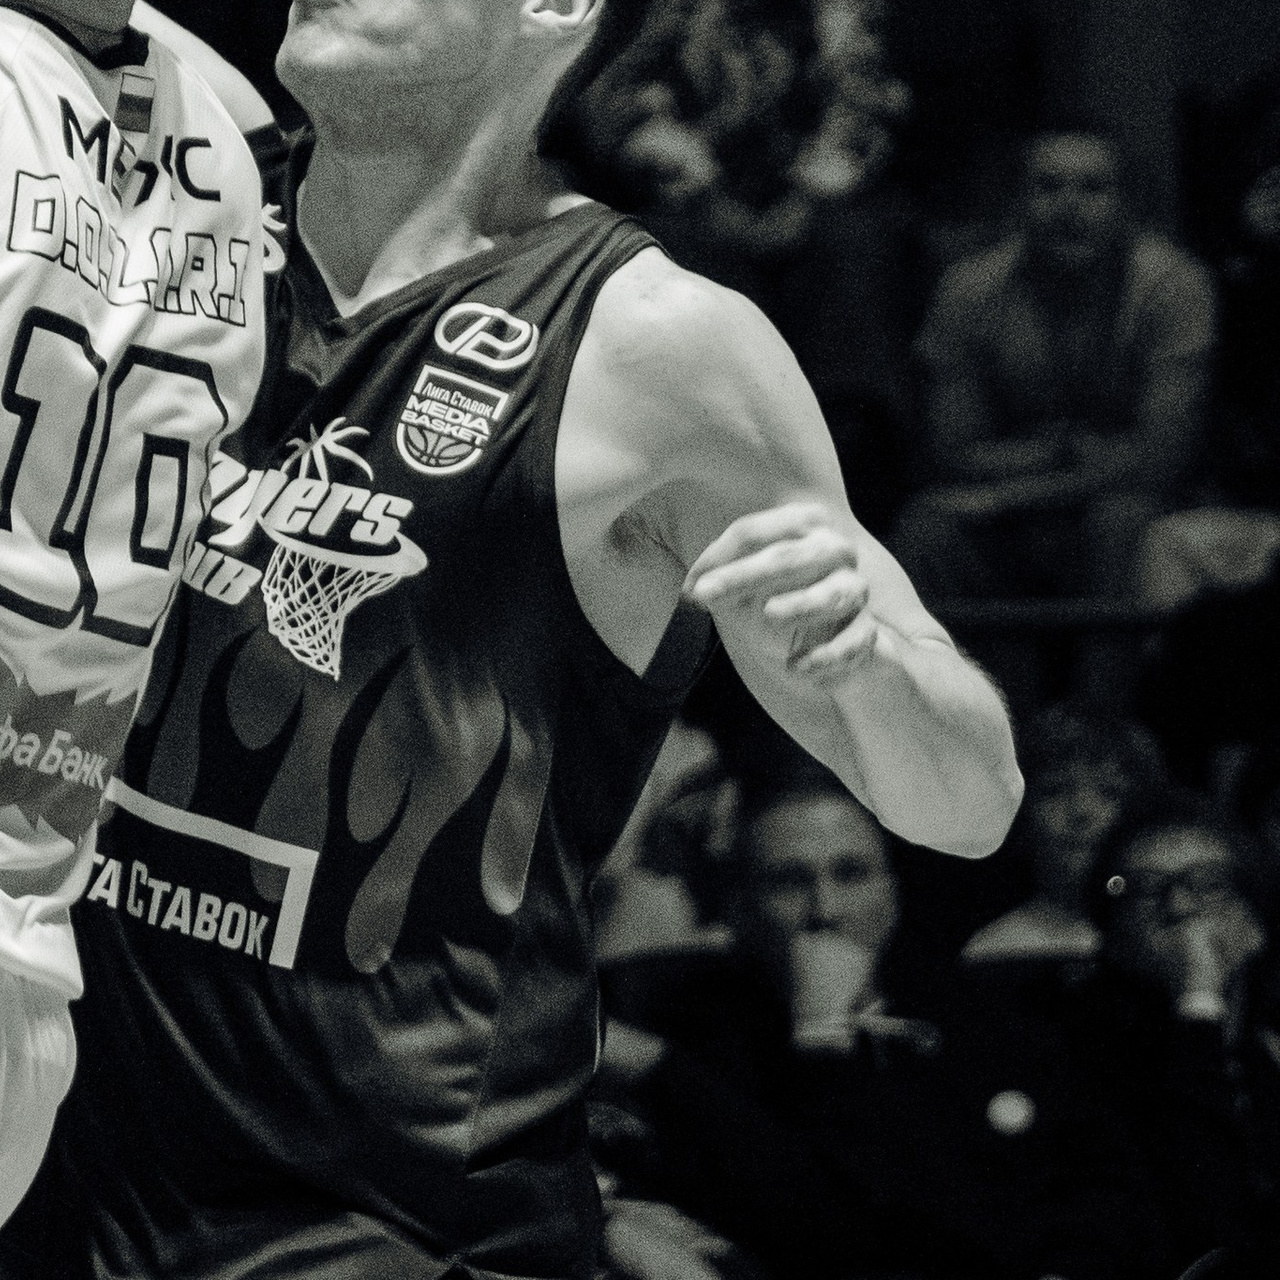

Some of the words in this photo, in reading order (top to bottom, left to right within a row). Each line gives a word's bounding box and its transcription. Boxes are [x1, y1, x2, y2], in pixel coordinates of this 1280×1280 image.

[400, 409, 489, 446] BASKET
[406, 394, 489, 435] MEDIA
[209, 450, 414, 546] yers
